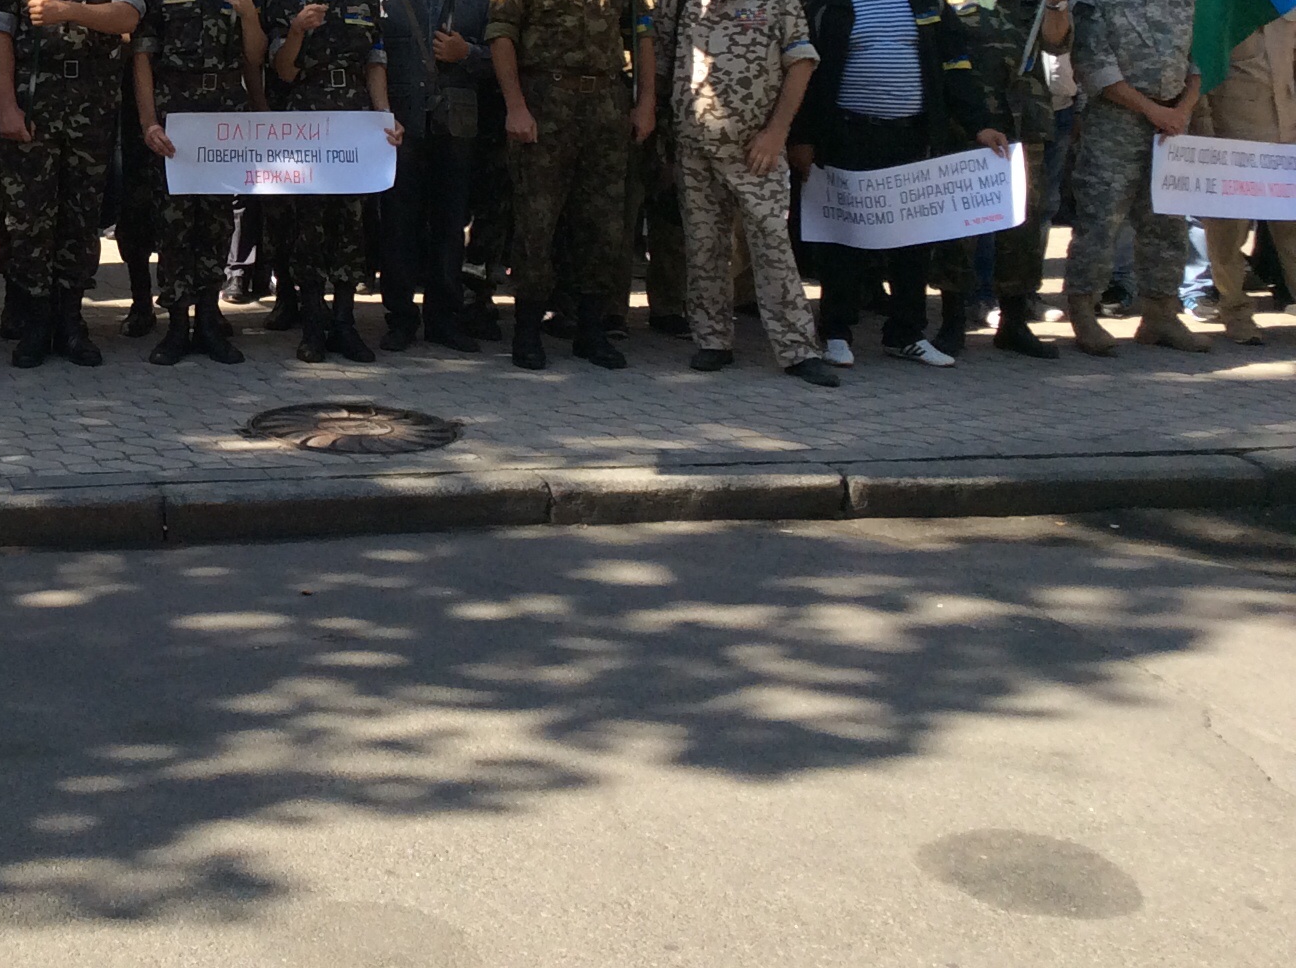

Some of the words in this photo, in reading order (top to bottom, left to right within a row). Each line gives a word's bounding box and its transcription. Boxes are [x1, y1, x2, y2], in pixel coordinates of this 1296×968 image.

[266, 148, 322, 164] ВКРАДЕНІ
[326, 147, 359, 164] ГРОШІ
[858, 168, 931, 192] ГАНЕБНИМ
[938, 157, 989, 179] МИРОМ
[899, 179, 974, 205] ОБИРАЮЧИ
[822, 206, 895, 226] ОТРИМАЄМО
[900, 200, 945, 222] ГАНЬБУ
[962, 190, 1002, 211] ВІЙНУ
